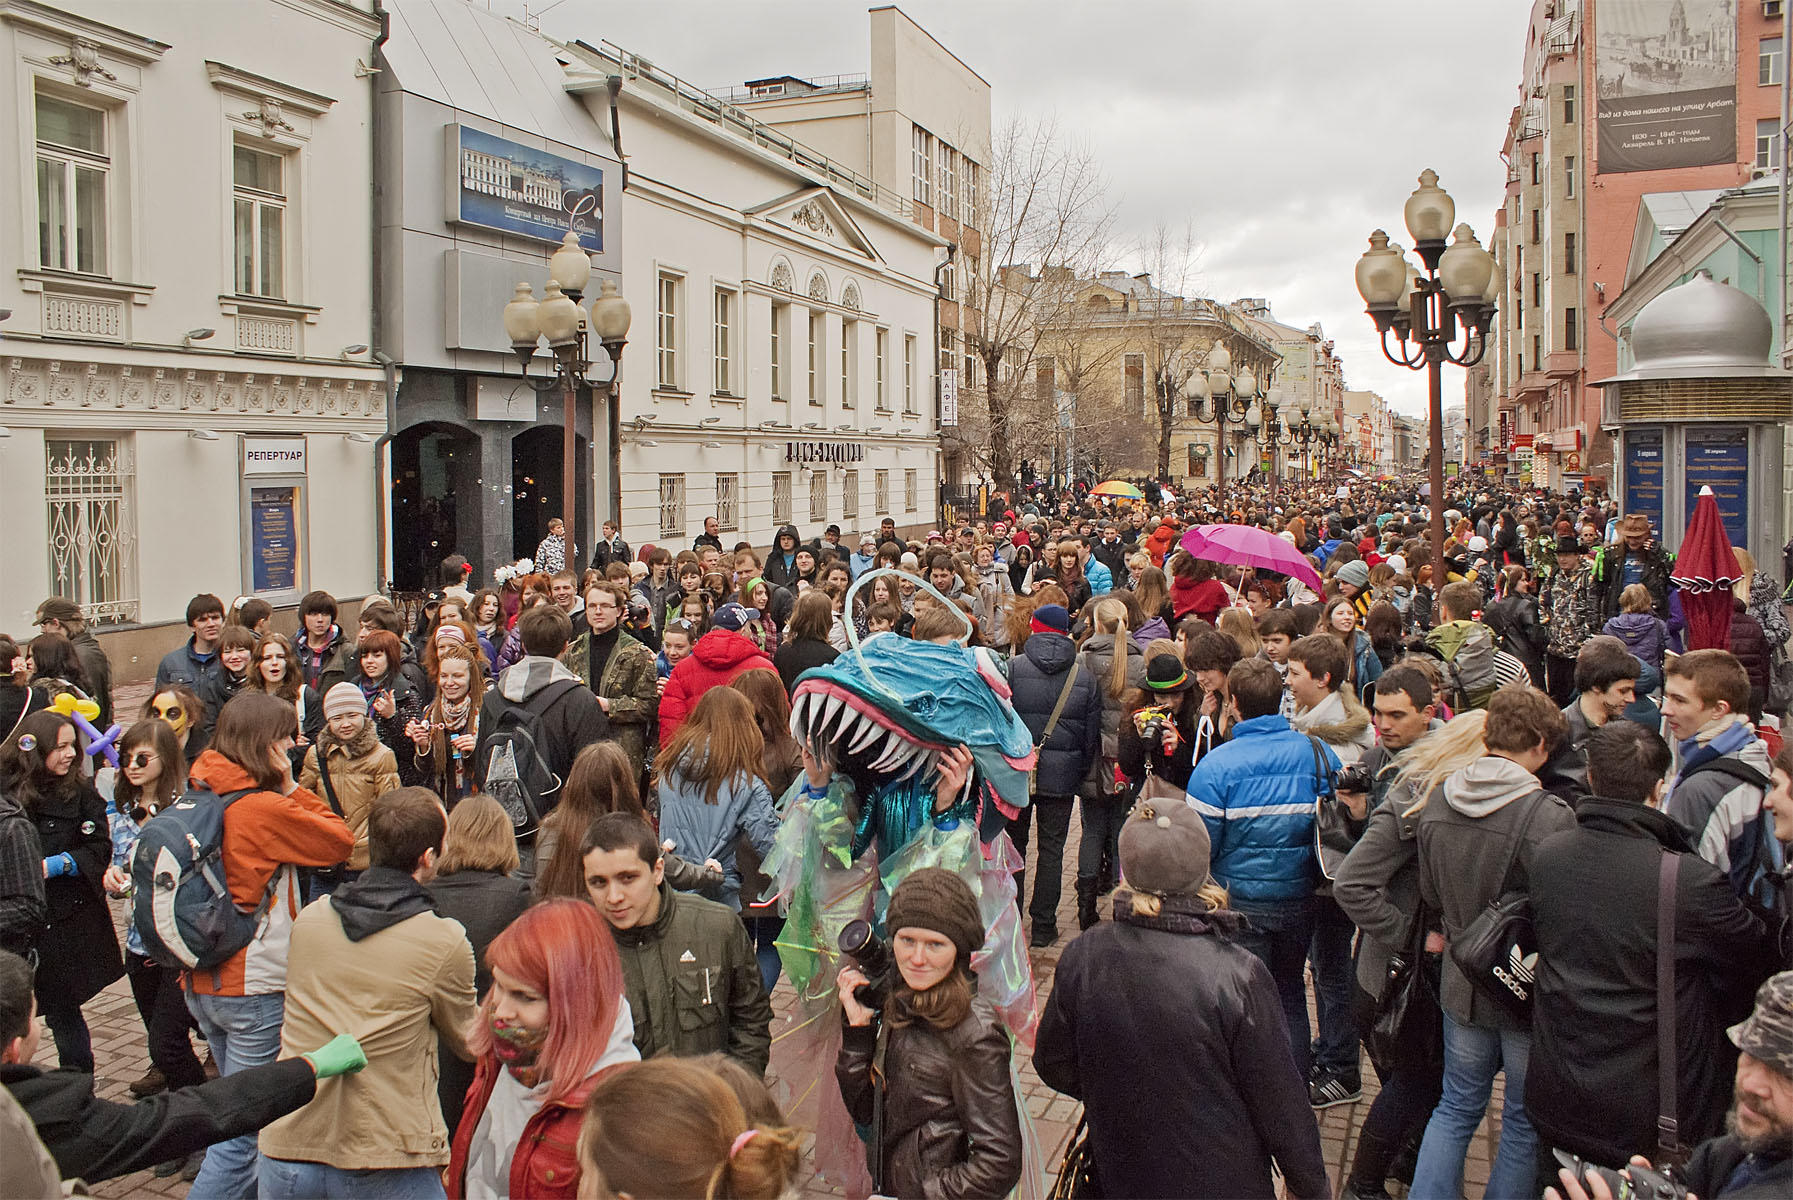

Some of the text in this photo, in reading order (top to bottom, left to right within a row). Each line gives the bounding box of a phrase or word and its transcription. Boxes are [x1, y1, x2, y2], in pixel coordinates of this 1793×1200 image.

[1599, 111, 1612, 119] Вид
[1643, 106, 1670, 115] нашего
[1682, 102, 1705, 112] улицу
[1706, 99, 1734, 110] Арбат.
[943, 371, 951, 411] КАФЕ
[248, 451, 303, 461] РЕПЕРТУАР
[1492, 966, 1528, 1000] adidas
